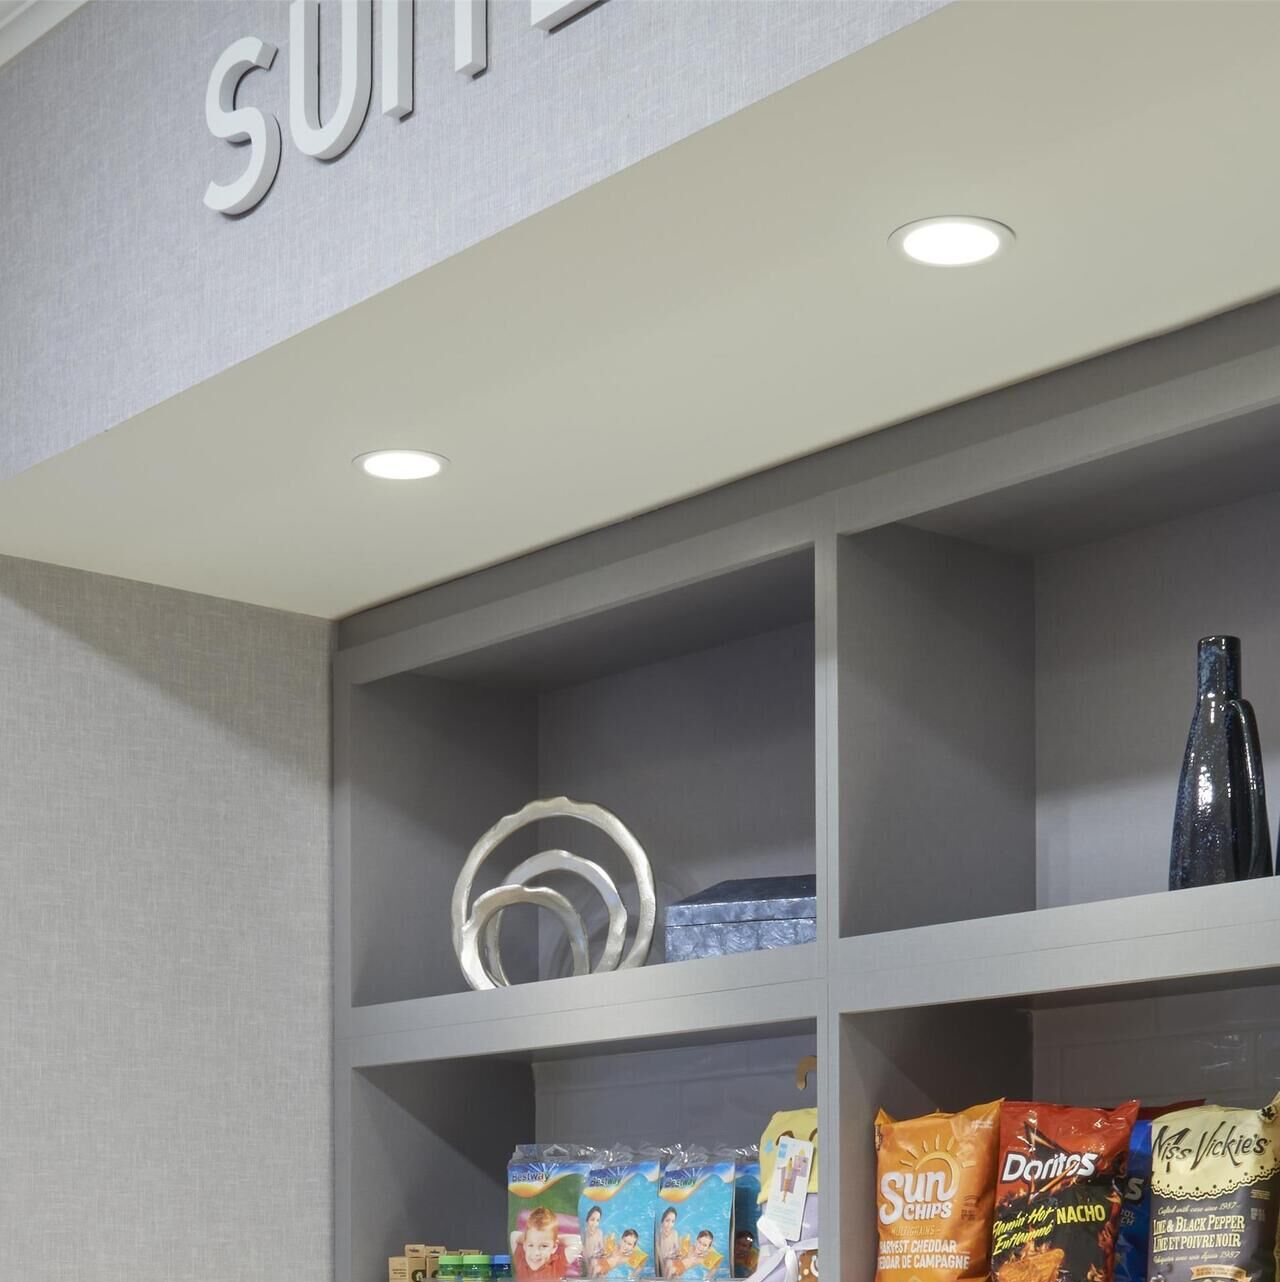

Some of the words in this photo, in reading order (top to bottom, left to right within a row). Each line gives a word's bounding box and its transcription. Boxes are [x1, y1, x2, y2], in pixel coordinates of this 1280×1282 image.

[204, 0, 610, 218] SUI
[1152, 1125, 1192, 1173] Miss
[1191, 1121, 1267, 1170] Vickie's
[1001, 1153, 1099, 1183] Doritos
[879, 1170, 960, 1224] Sun
[904, 1202, 952, 1219] CHIPS
[1028, 1205, 1053, 1224] Hot
[1056, 1205, 1106, 1224] NACHO
[1167, 1221, 1174, 1233] &
[1176, 1217, 1205, 1233] BLACK
[1207, 1215, 1245, 1230] PEPPER
[911, 1240, 956, 1252] CHEDDAR
[1181, 1234, 1216, 1249] POIVRE
[1216, 1233, 1241, 1248] NOIR
[902, 1257, 912, 1268] DE
[914, 1255, 970, 1269] CAMPAGNE
